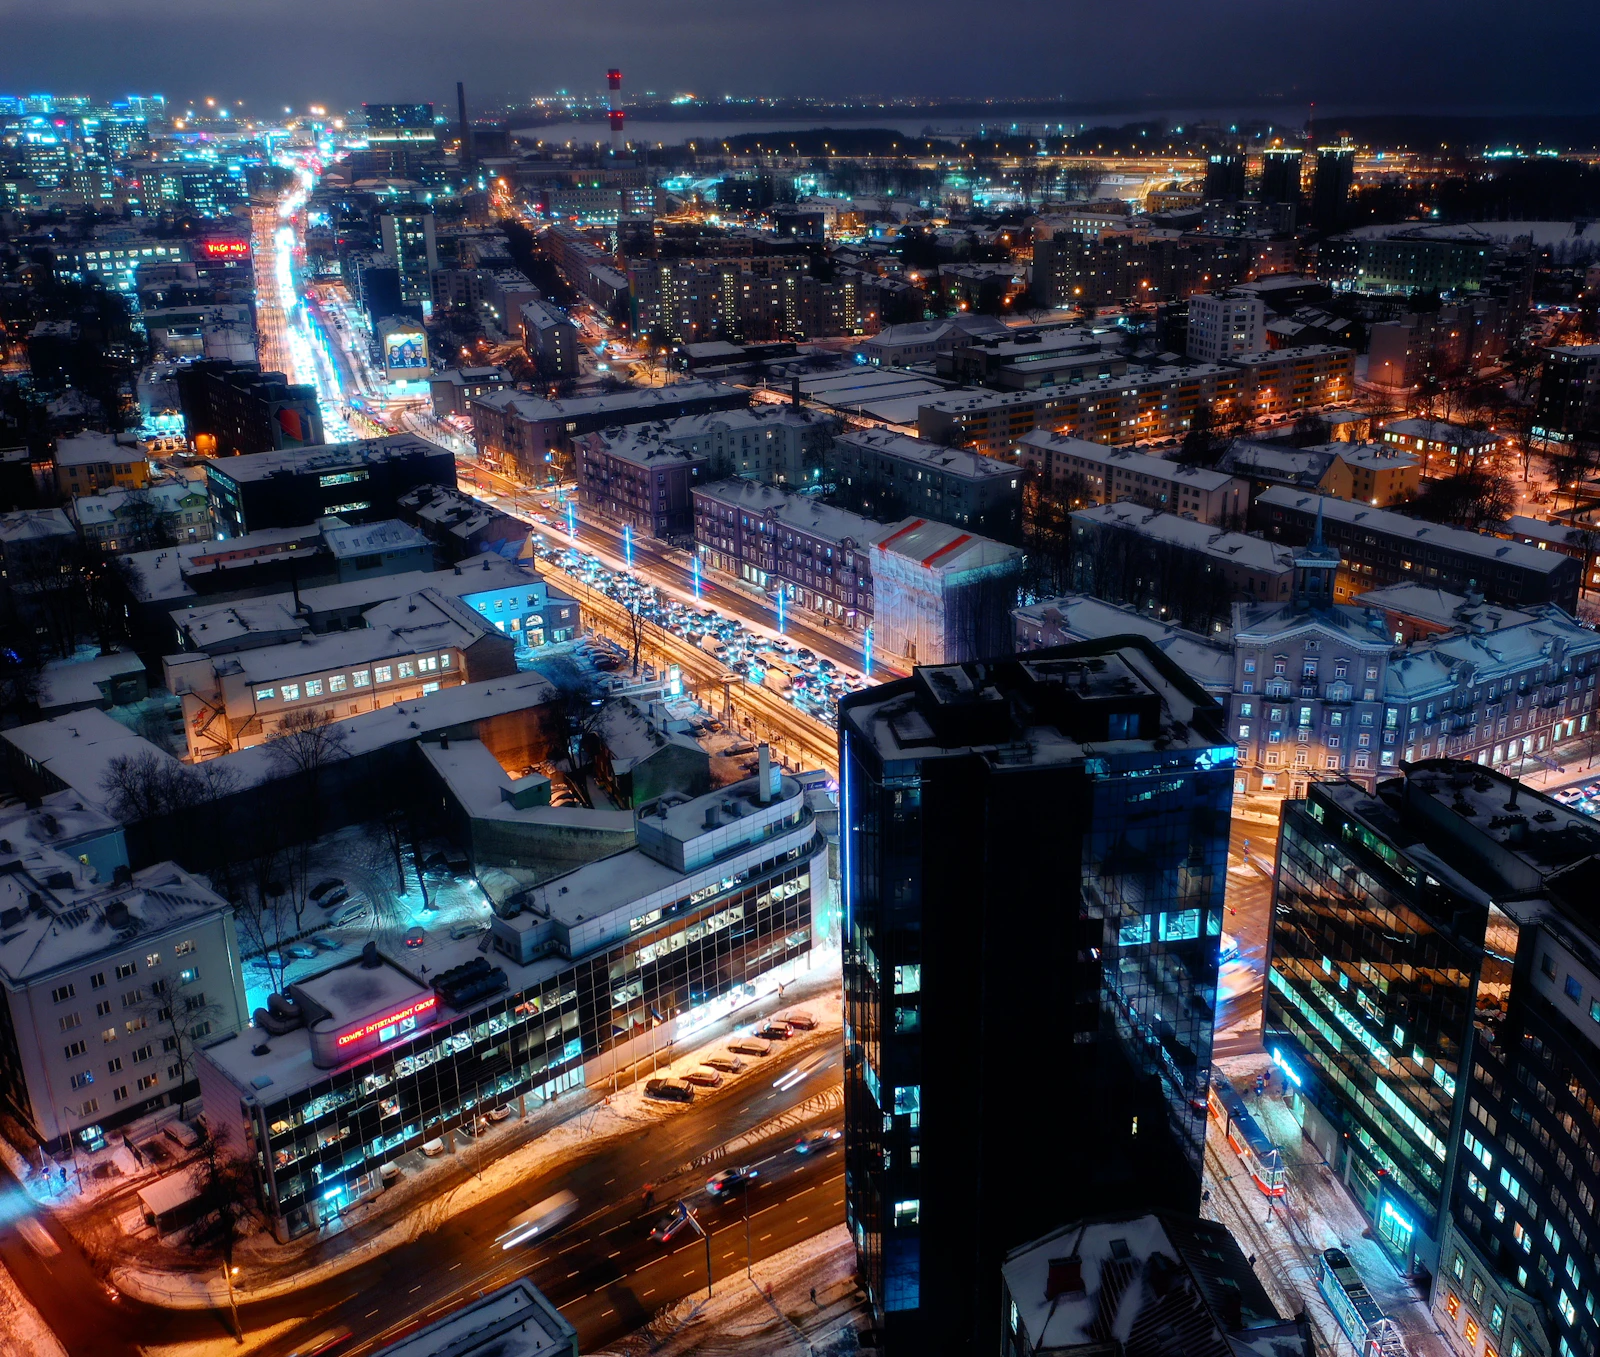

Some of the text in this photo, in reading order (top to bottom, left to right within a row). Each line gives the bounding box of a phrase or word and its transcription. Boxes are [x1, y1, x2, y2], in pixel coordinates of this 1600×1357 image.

[338, 998, 435, 1045] OLYMPIC ENTERTAINMENT GROUP
